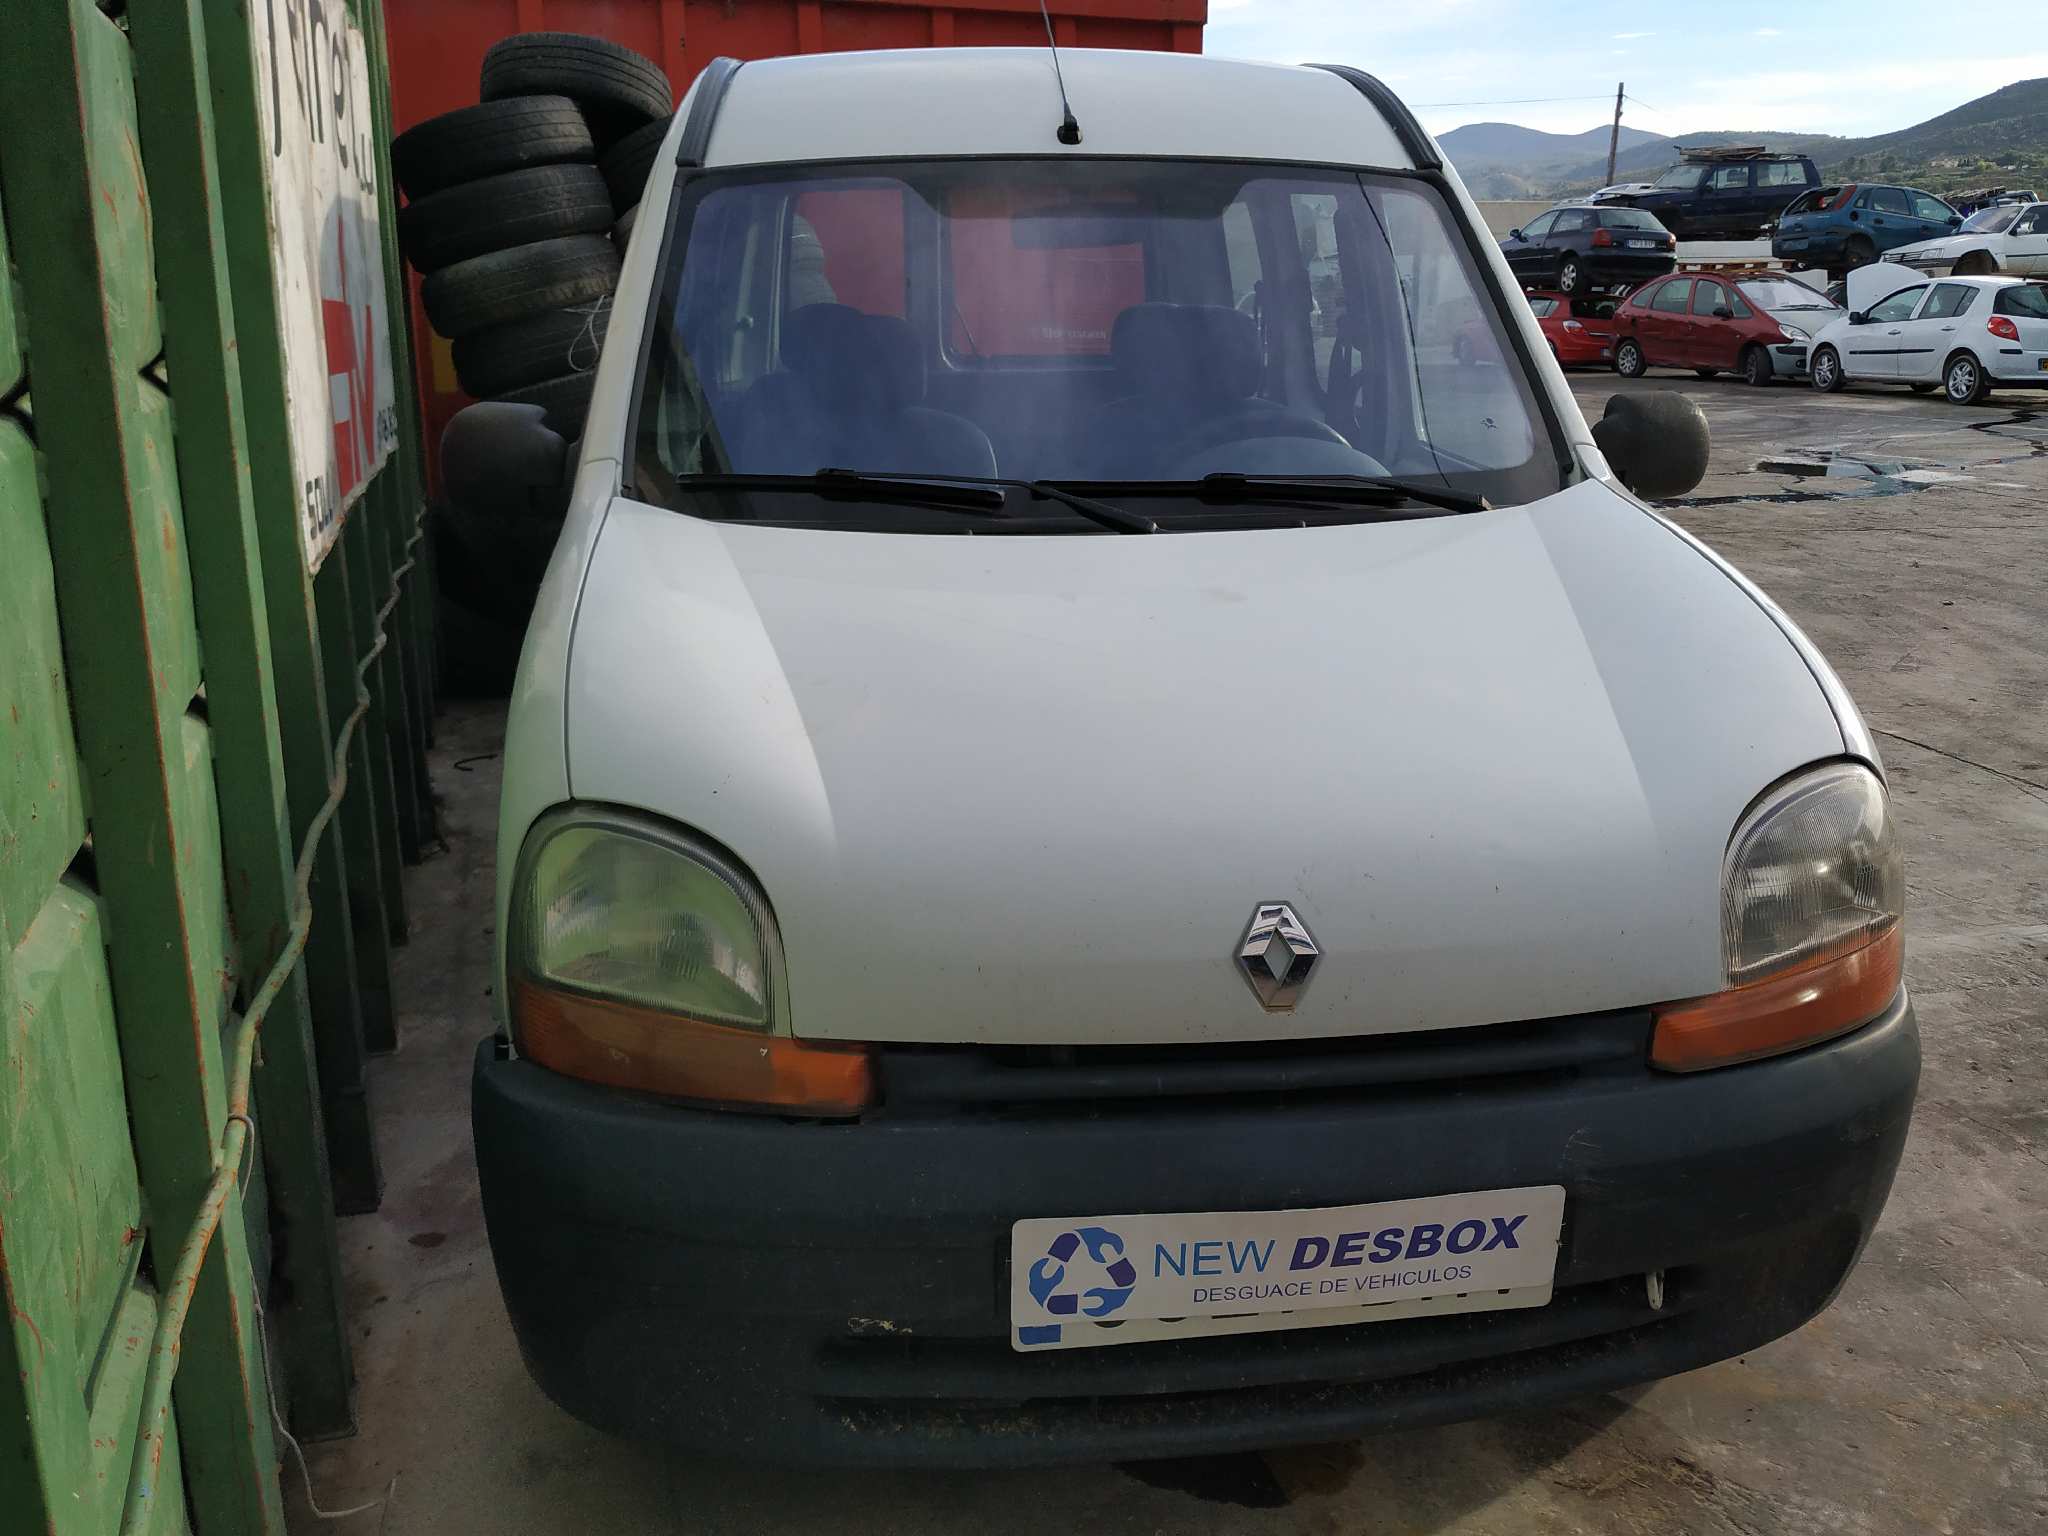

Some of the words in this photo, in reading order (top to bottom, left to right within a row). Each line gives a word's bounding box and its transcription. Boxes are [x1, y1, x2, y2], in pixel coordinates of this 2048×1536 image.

[1154, 1240, 1275, 1277] NEW
[1289, 1214, 1528, 1271] DESBOX
[1193, 1281, 1312, 1303] DESGUACE
[1319, 1277, 1349, 1294] DE
[1355, 1265, 1472, 1291] VEHICULOS
